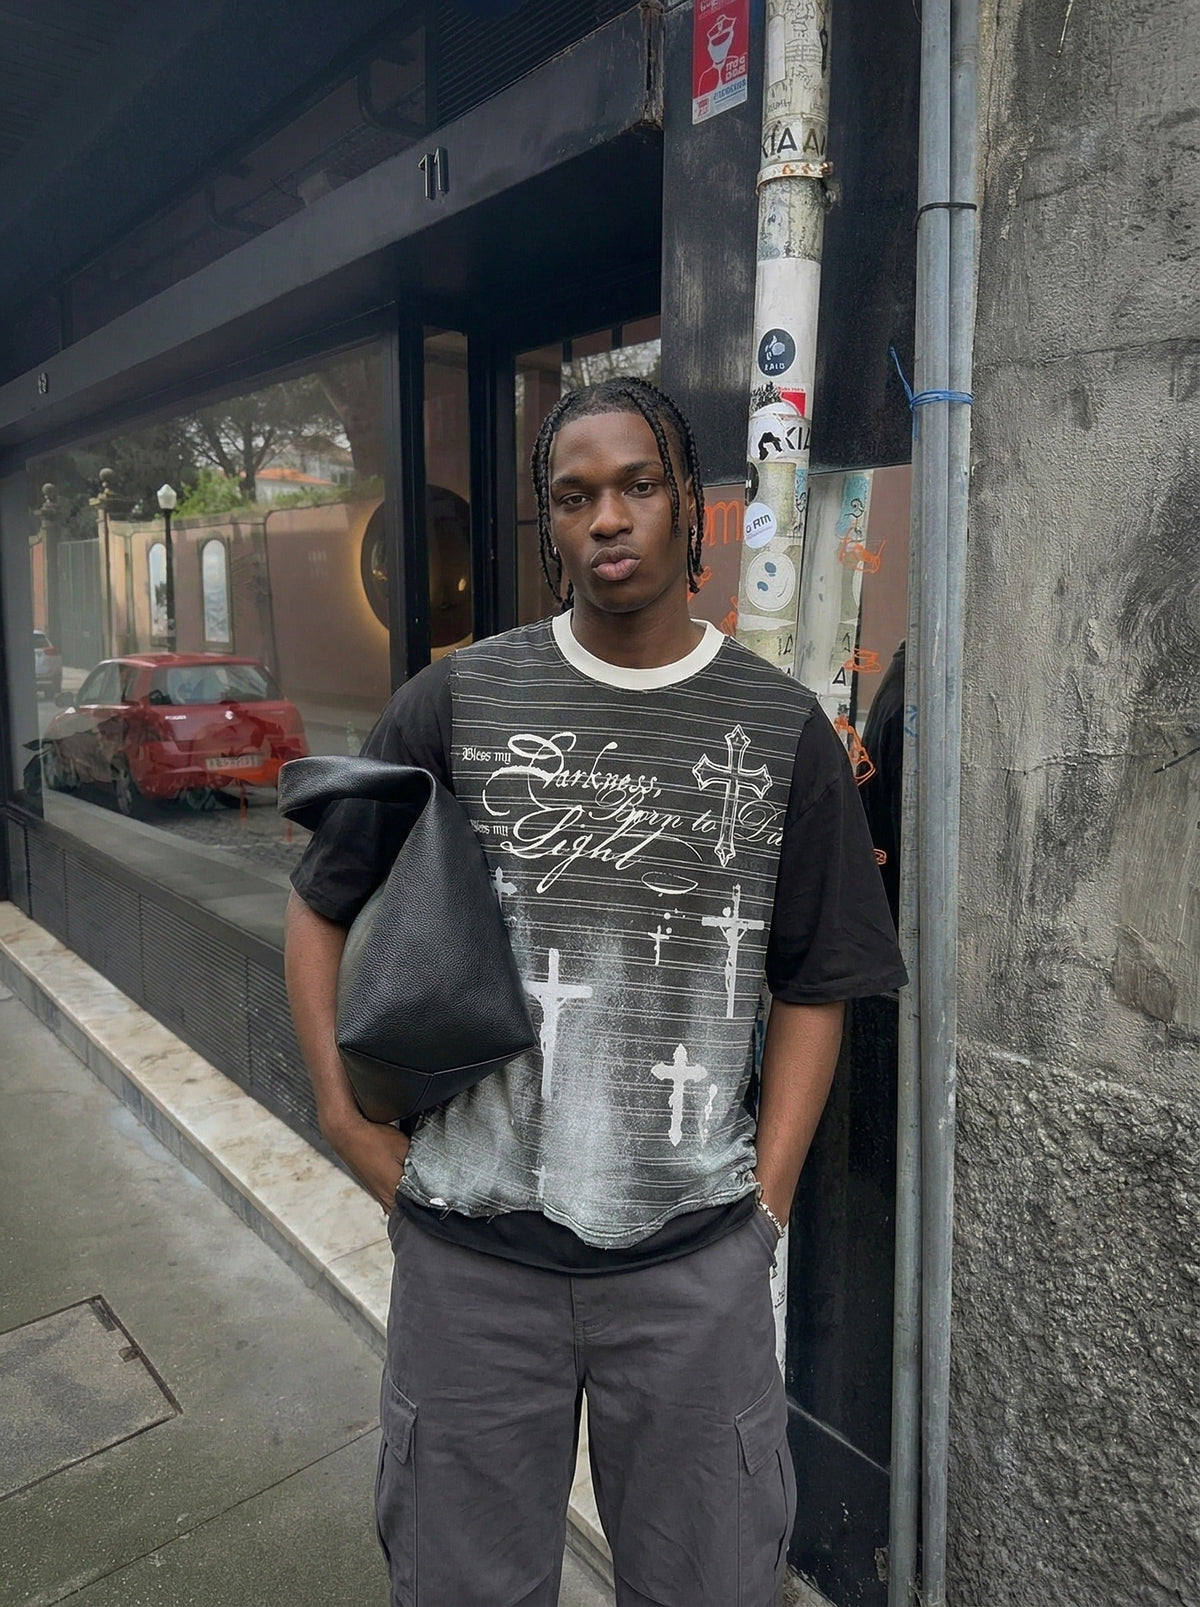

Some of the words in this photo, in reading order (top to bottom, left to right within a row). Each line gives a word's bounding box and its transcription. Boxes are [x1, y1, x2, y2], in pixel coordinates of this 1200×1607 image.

[417, 146, 450, 201] 11
[461, 747, 492, 762] Bless
[494, 751, 512, 765] my
[493, 825, 509, 838] my
[690, 809, 717, 833] to
